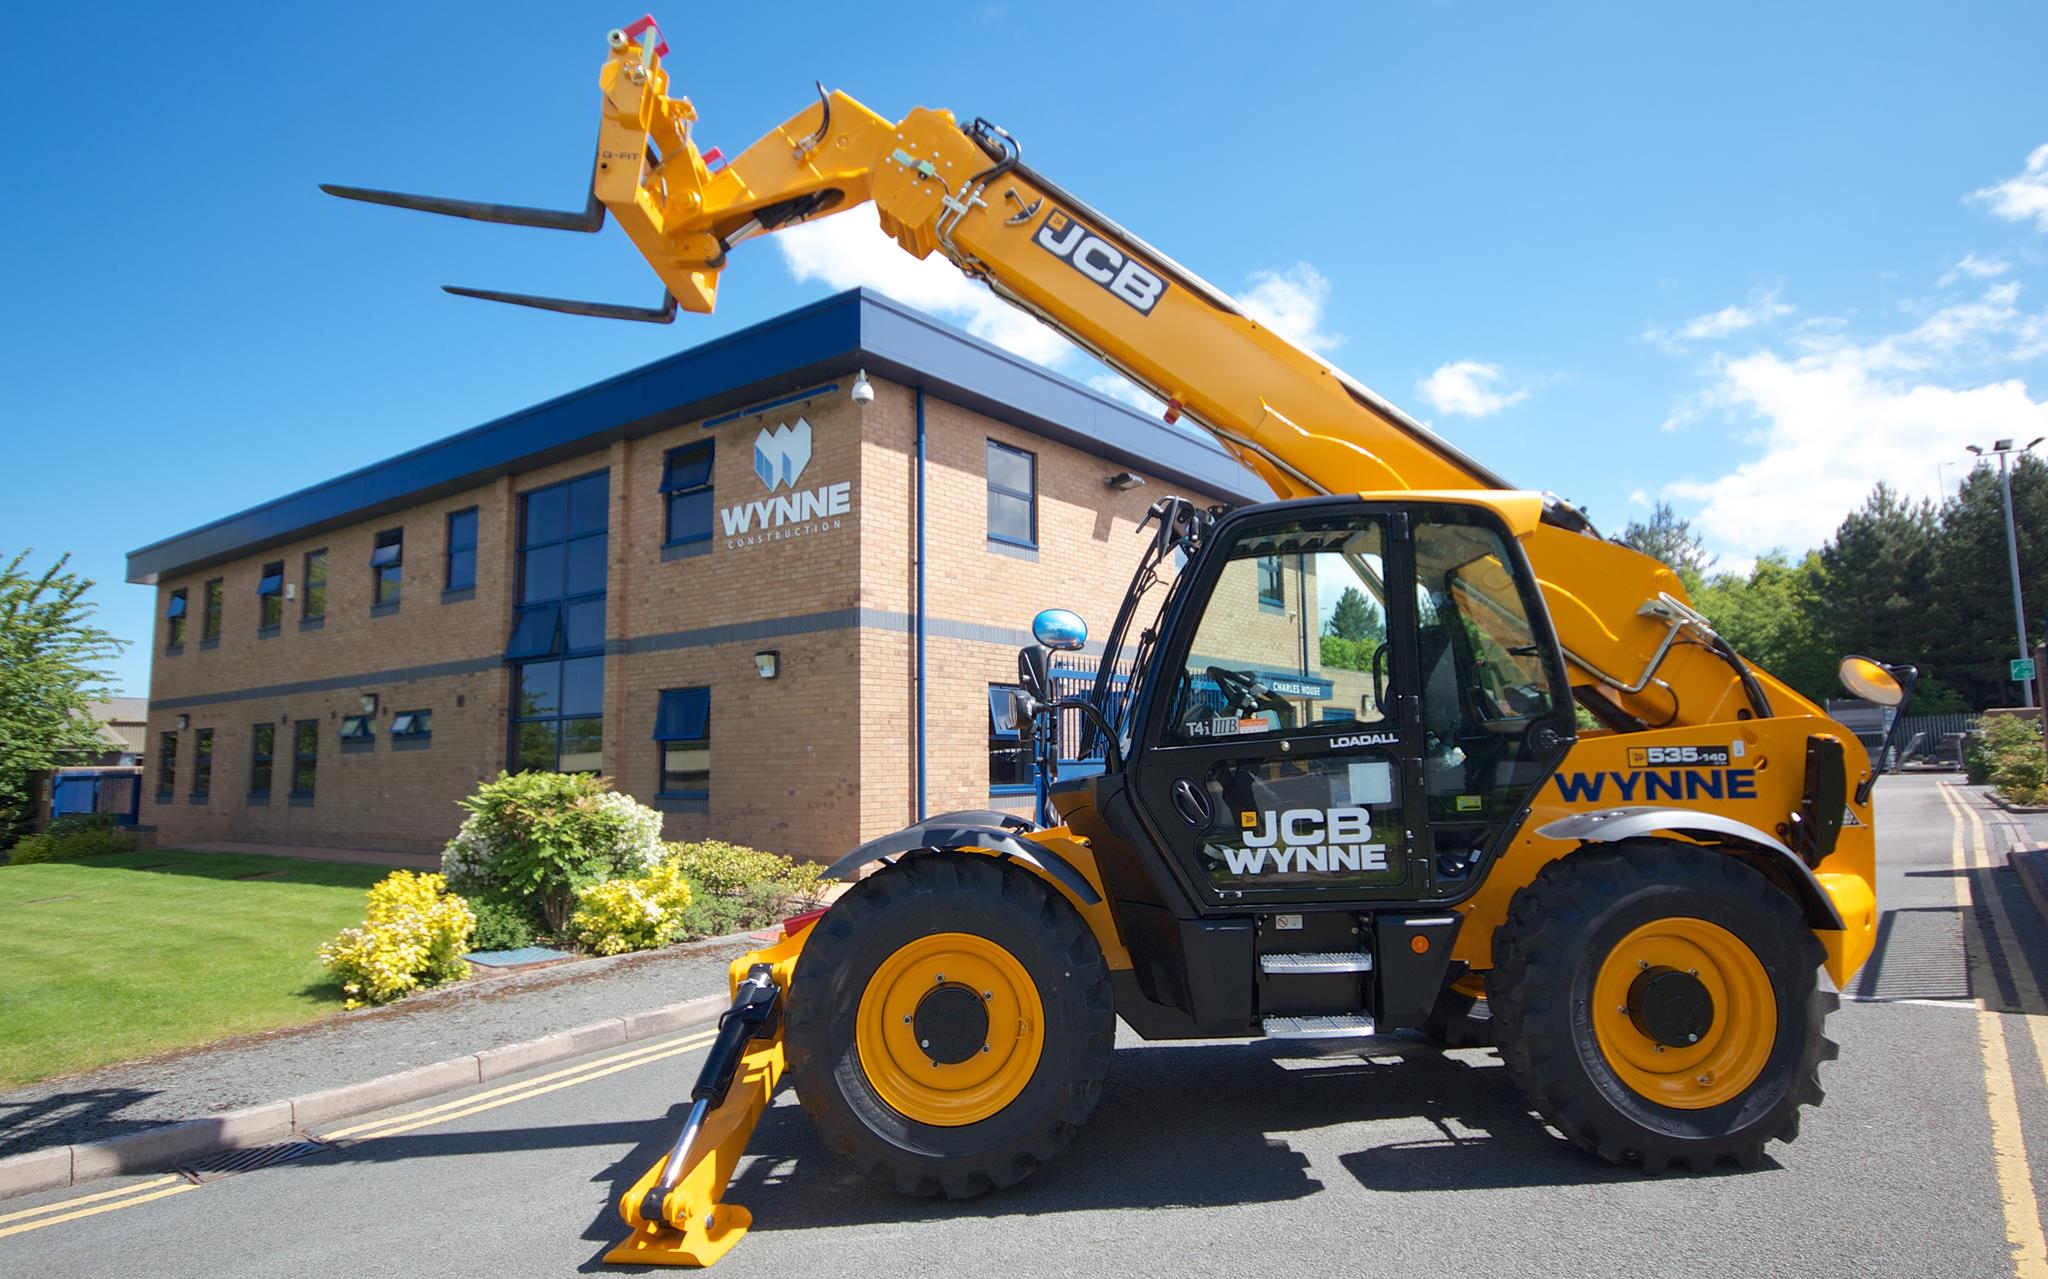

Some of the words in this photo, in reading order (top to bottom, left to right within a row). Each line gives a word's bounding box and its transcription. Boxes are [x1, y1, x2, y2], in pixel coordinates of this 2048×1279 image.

[1039, 224, 1162, 310] JCB
[720, 481, 851, 536] WYNNE
[727, 520, 841, 549] CONSTRUCTION
[1273, 681, 1300, 694] CHARLES
[1301, 685, 1321, 696] HOUSE
[1185, 720, 1211, 737] T4i
[1330, 733, 1399, 748] LOADALL
[1646, 746, 1727, 763] 535-140
[1554, 769, 1758, 803] WYNNE
[1242, 808, 1372, 848] JCB
[1222, 844, 1388, 875] WYNNE
